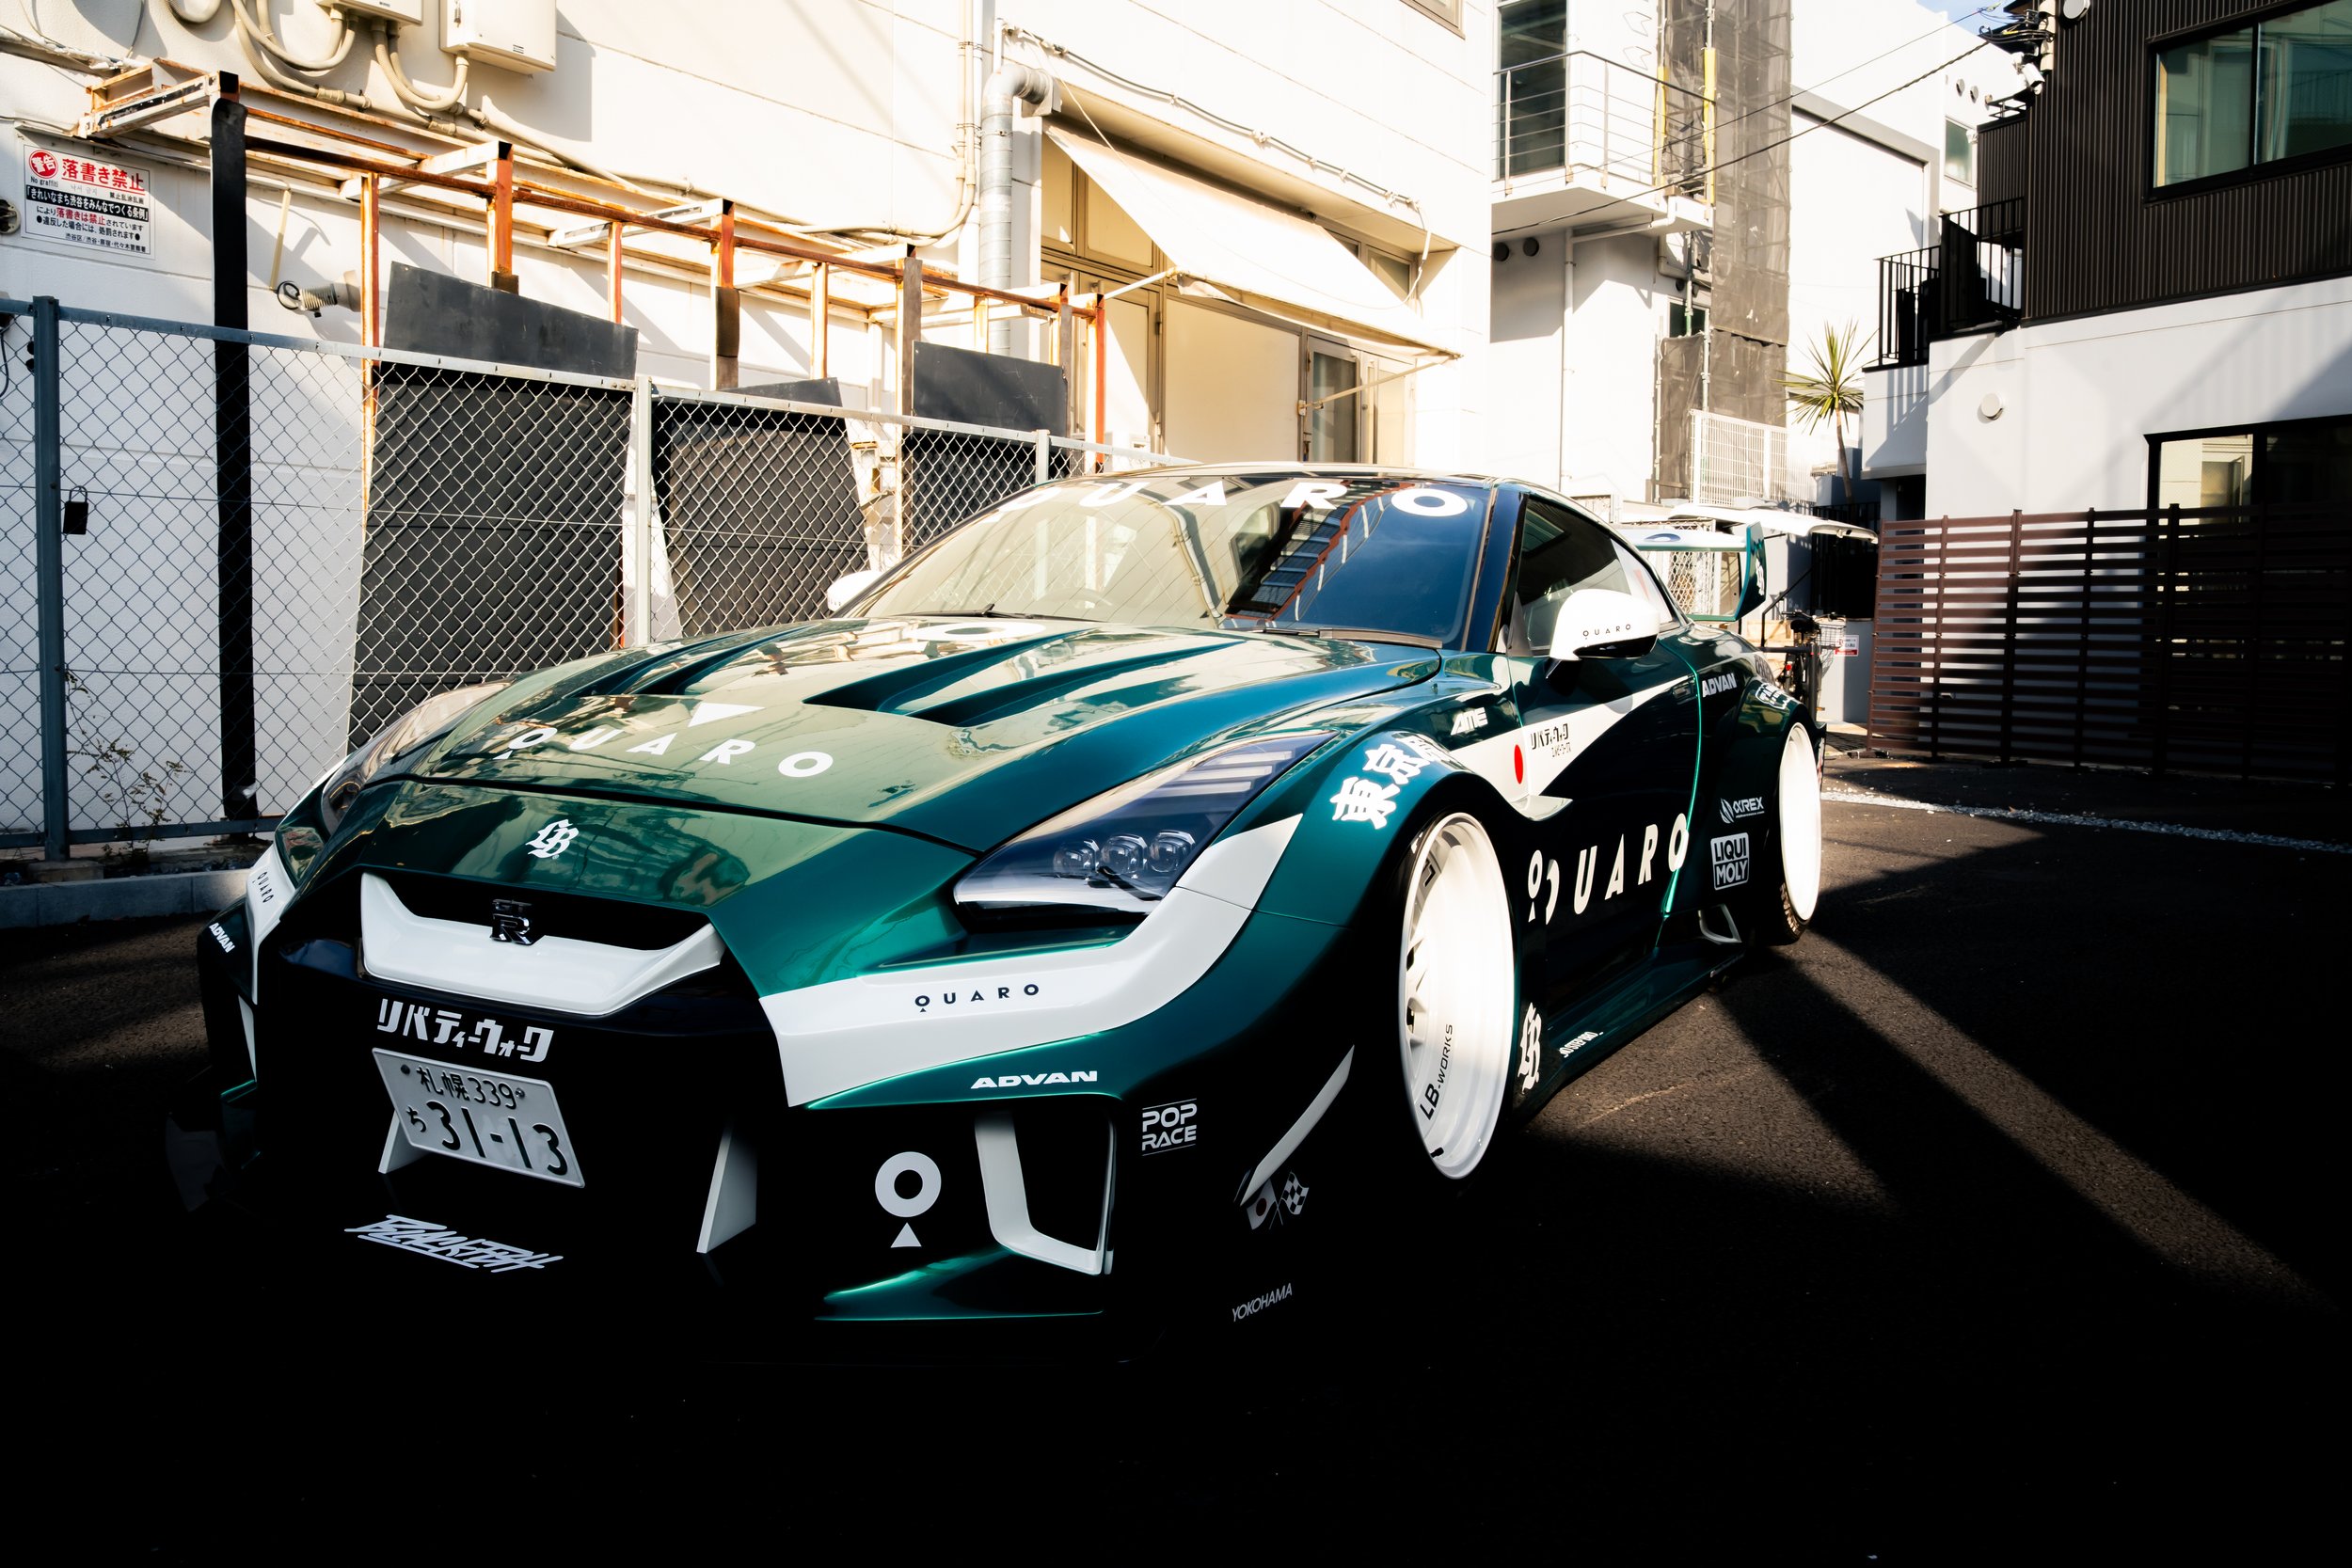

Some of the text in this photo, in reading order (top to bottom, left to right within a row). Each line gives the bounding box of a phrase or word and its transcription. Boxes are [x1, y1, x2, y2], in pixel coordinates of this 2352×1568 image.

[40, 179, 59, 188] graffiti
[62, 158, 145, 191] 落書き禁止
[37, 206, 143, 231] により落書きは禁止されています
[1582, 624, 1631, 640] QUARO
[1702, 673, 1737, 697] ADVAN
[493, 727, 834, 778] QUARO
[1714, 837, 1746, 863] LIQUI
[1528, 813, 1690, 926] QUARO
[1716, 860, 1748, 885] MOLY
[252, 871, 274, 903] QUARO
[209, 923, 235, 953] ADVAN
[915, 984, 1040, 1013] QUARO
[377, 998, 554, 1063] リバティーウォーク
[970, 1070, 1098, 1089] ADVAN
[1142, 1102, 1198, 1132] POP
[405, 1100, 568, 1177] ち 31-13
[1141, 1124, 1198, 1151] RACE
[1232, 1282, 1294, 1323] YOKOHAMA
